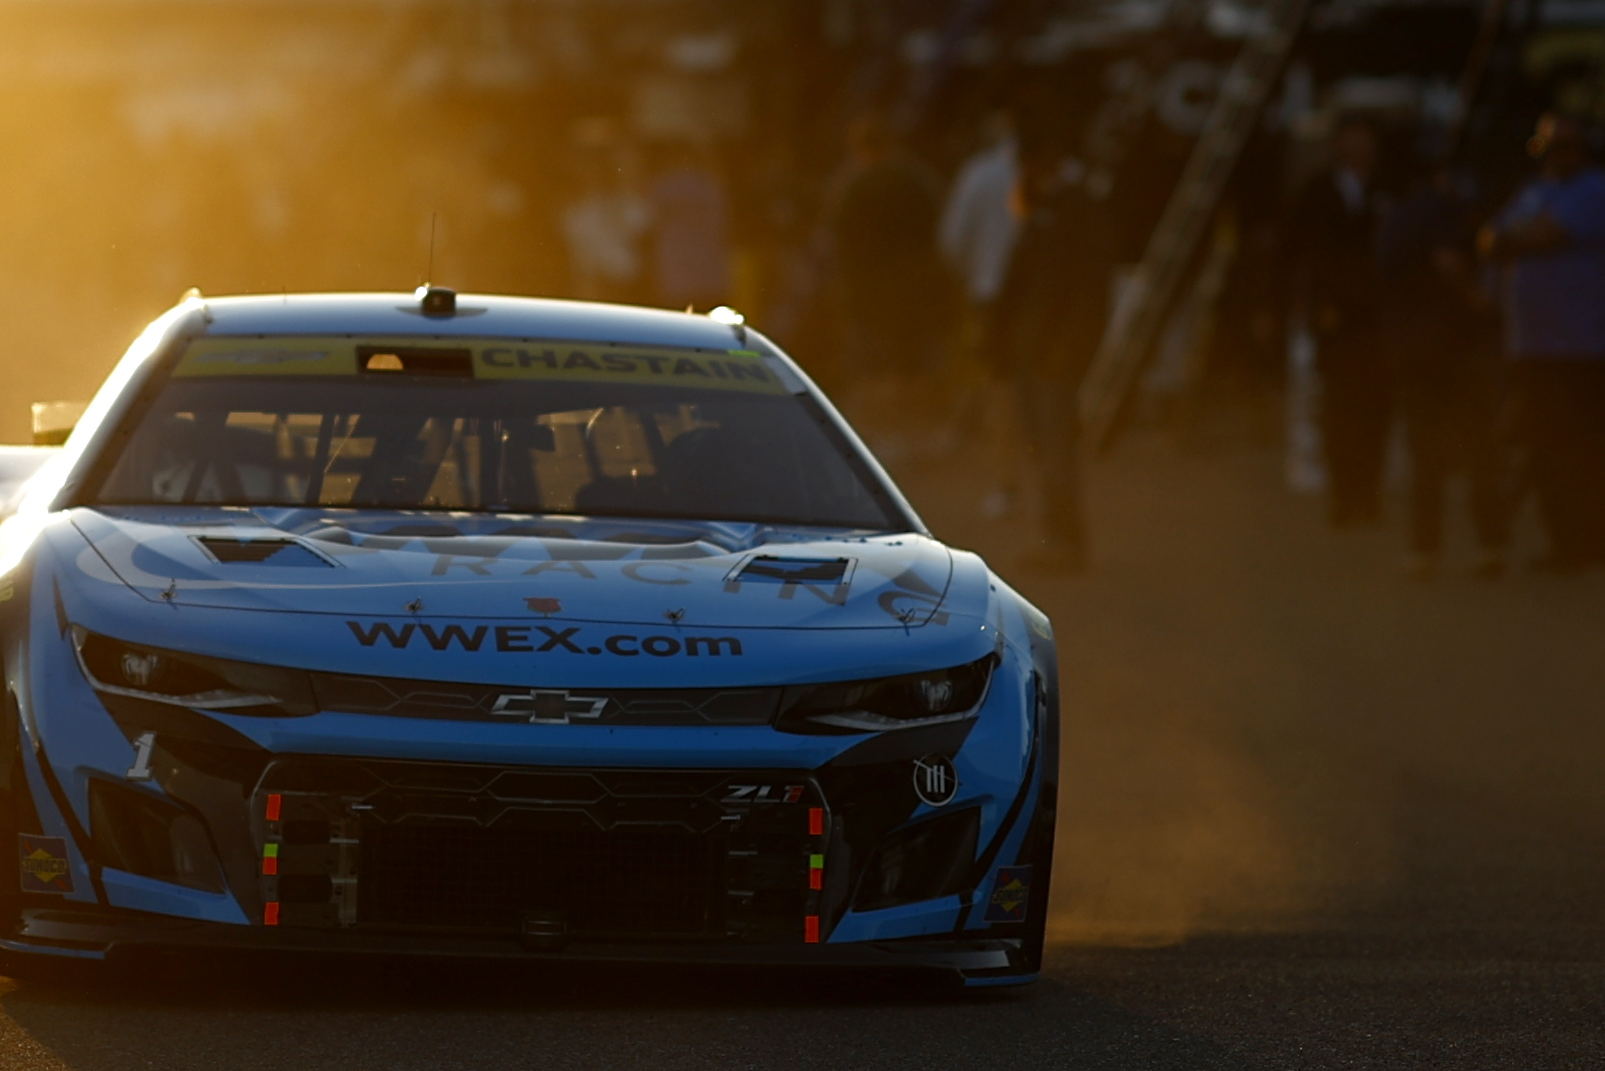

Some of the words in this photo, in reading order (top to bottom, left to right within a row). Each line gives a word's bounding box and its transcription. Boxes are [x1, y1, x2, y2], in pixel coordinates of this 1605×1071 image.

[481, 347, 771, 384] CHASTAIN
[346, 620, 743, 657] WWEX.com
[126, 731, 158, 781] 1
[720, 784, 805, 804] ZL1
